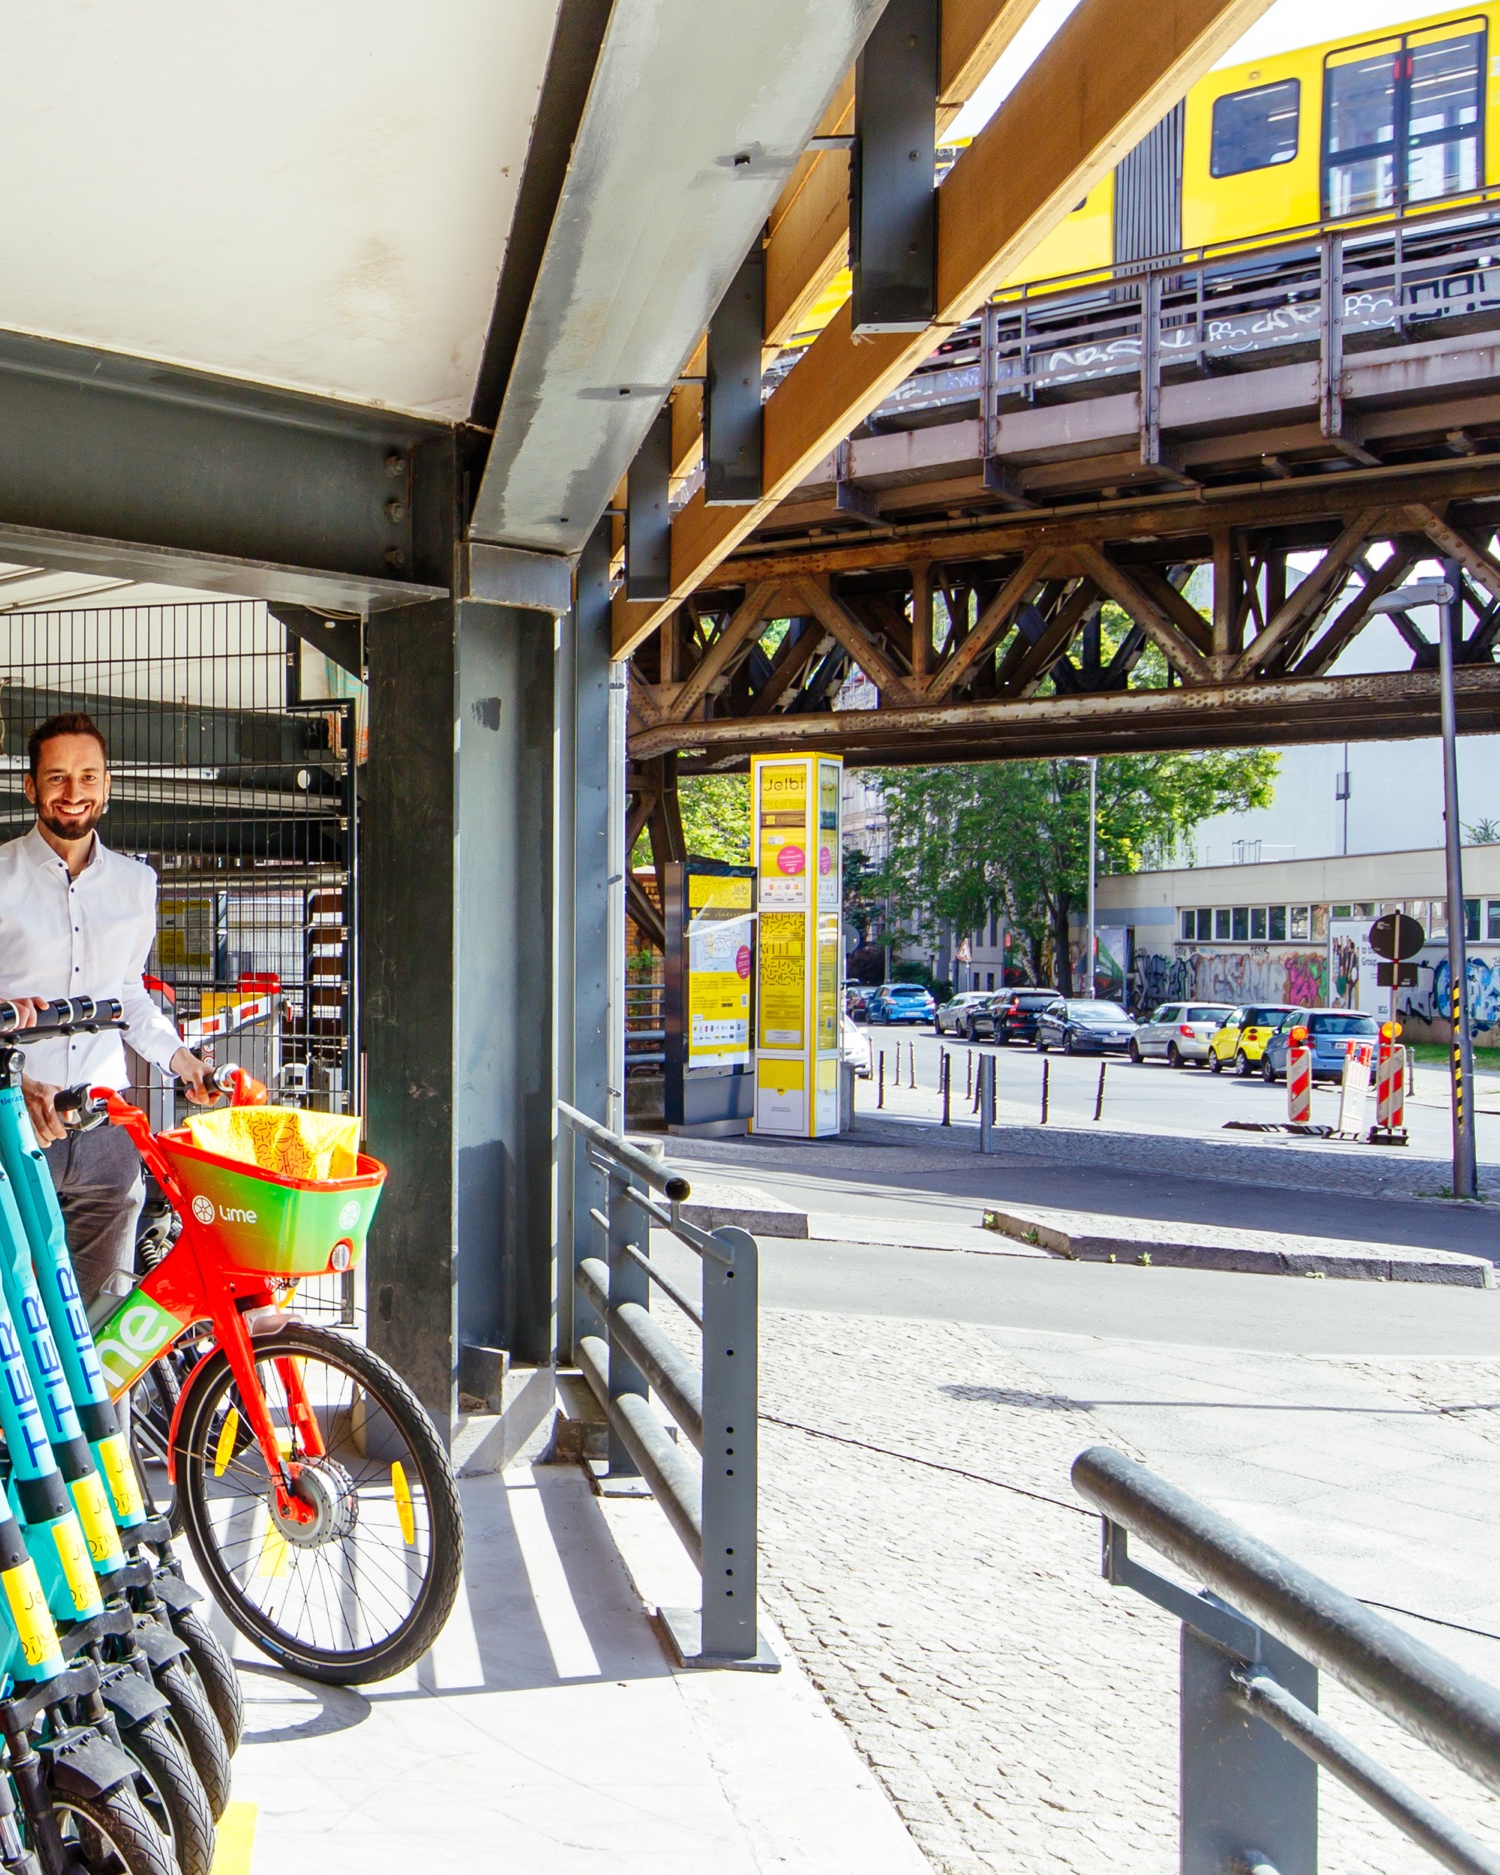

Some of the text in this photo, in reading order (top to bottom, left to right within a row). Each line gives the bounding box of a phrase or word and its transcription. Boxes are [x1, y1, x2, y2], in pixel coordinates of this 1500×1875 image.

[763, 777, 804, 792] Jelbi
[218, 1205, 258, 1225] Lime
[22, 1295, 73, 1434] TIER
[56, 1266, 100, 1395] TIER
